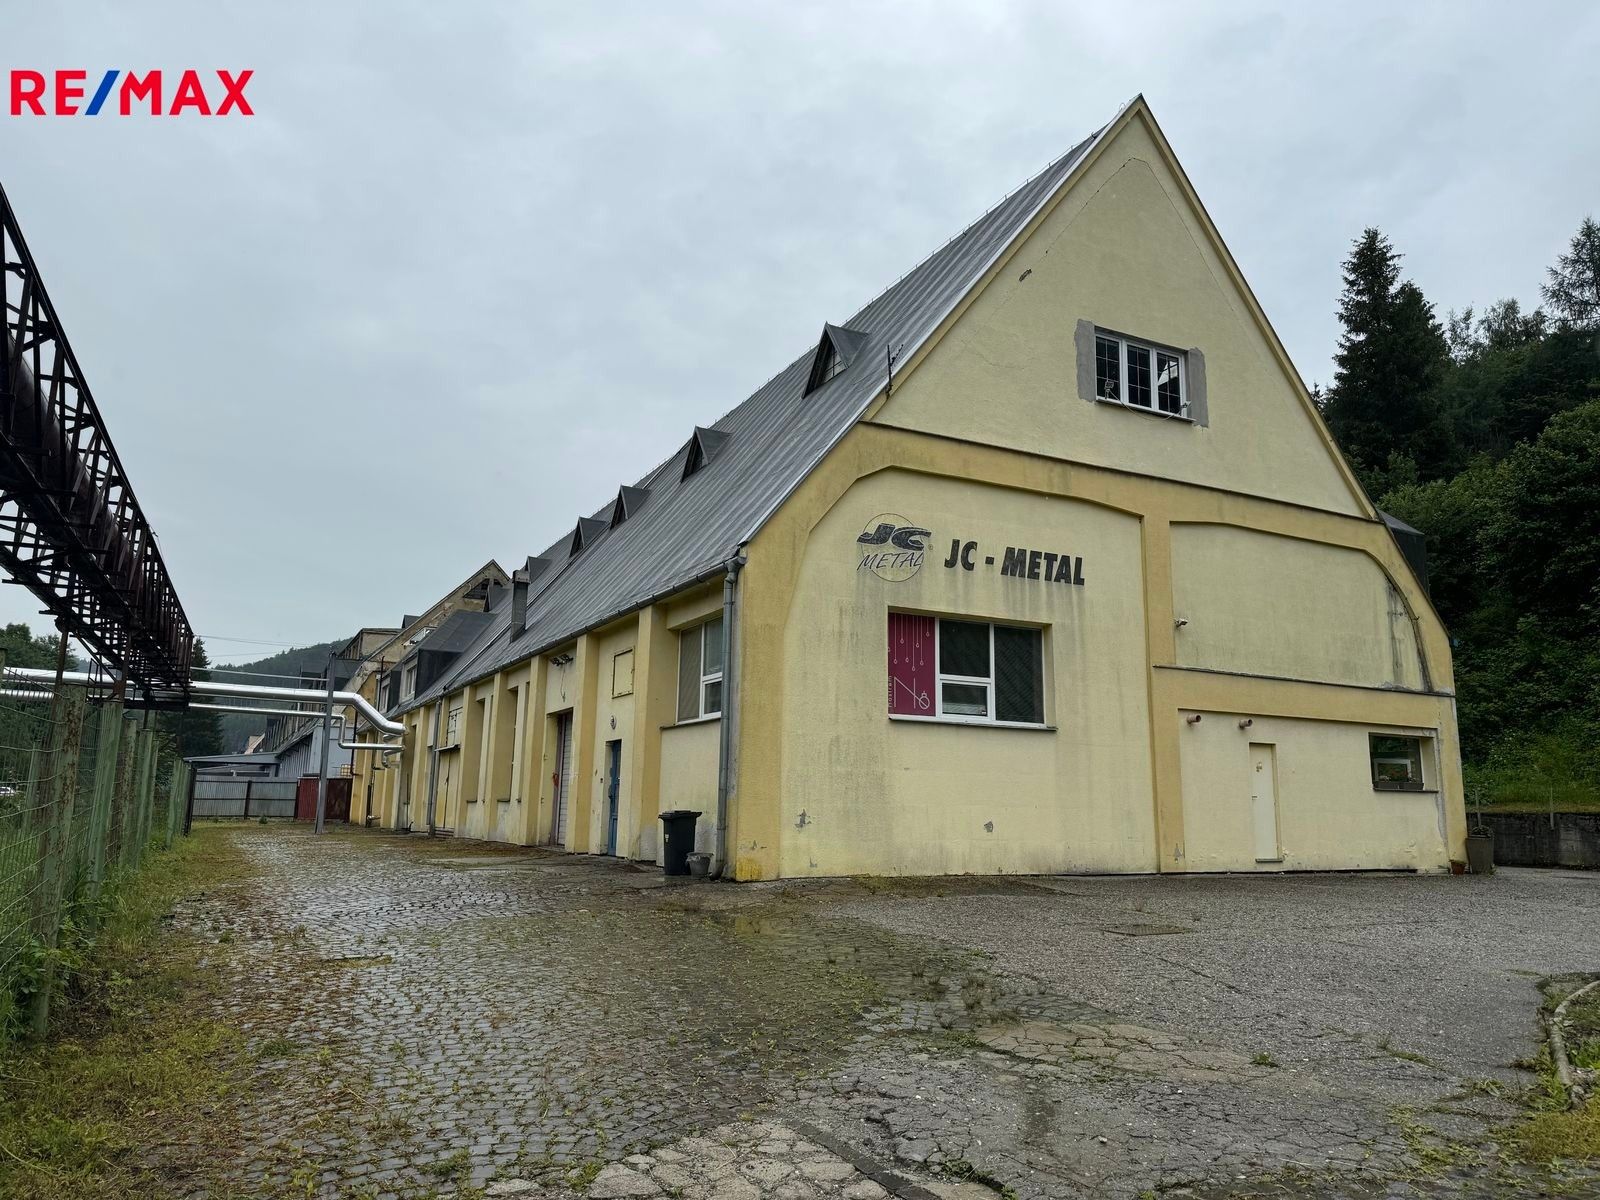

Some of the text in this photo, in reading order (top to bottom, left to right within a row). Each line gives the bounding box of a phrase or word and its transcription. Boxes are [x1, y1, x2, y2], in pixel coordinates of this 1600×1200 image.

[856, 522, 932, 551] JC
[856, 551, 925, 571] METAL
[944, 538, 978, 572] JC
[1000, 546, 1085, 586] METAL
